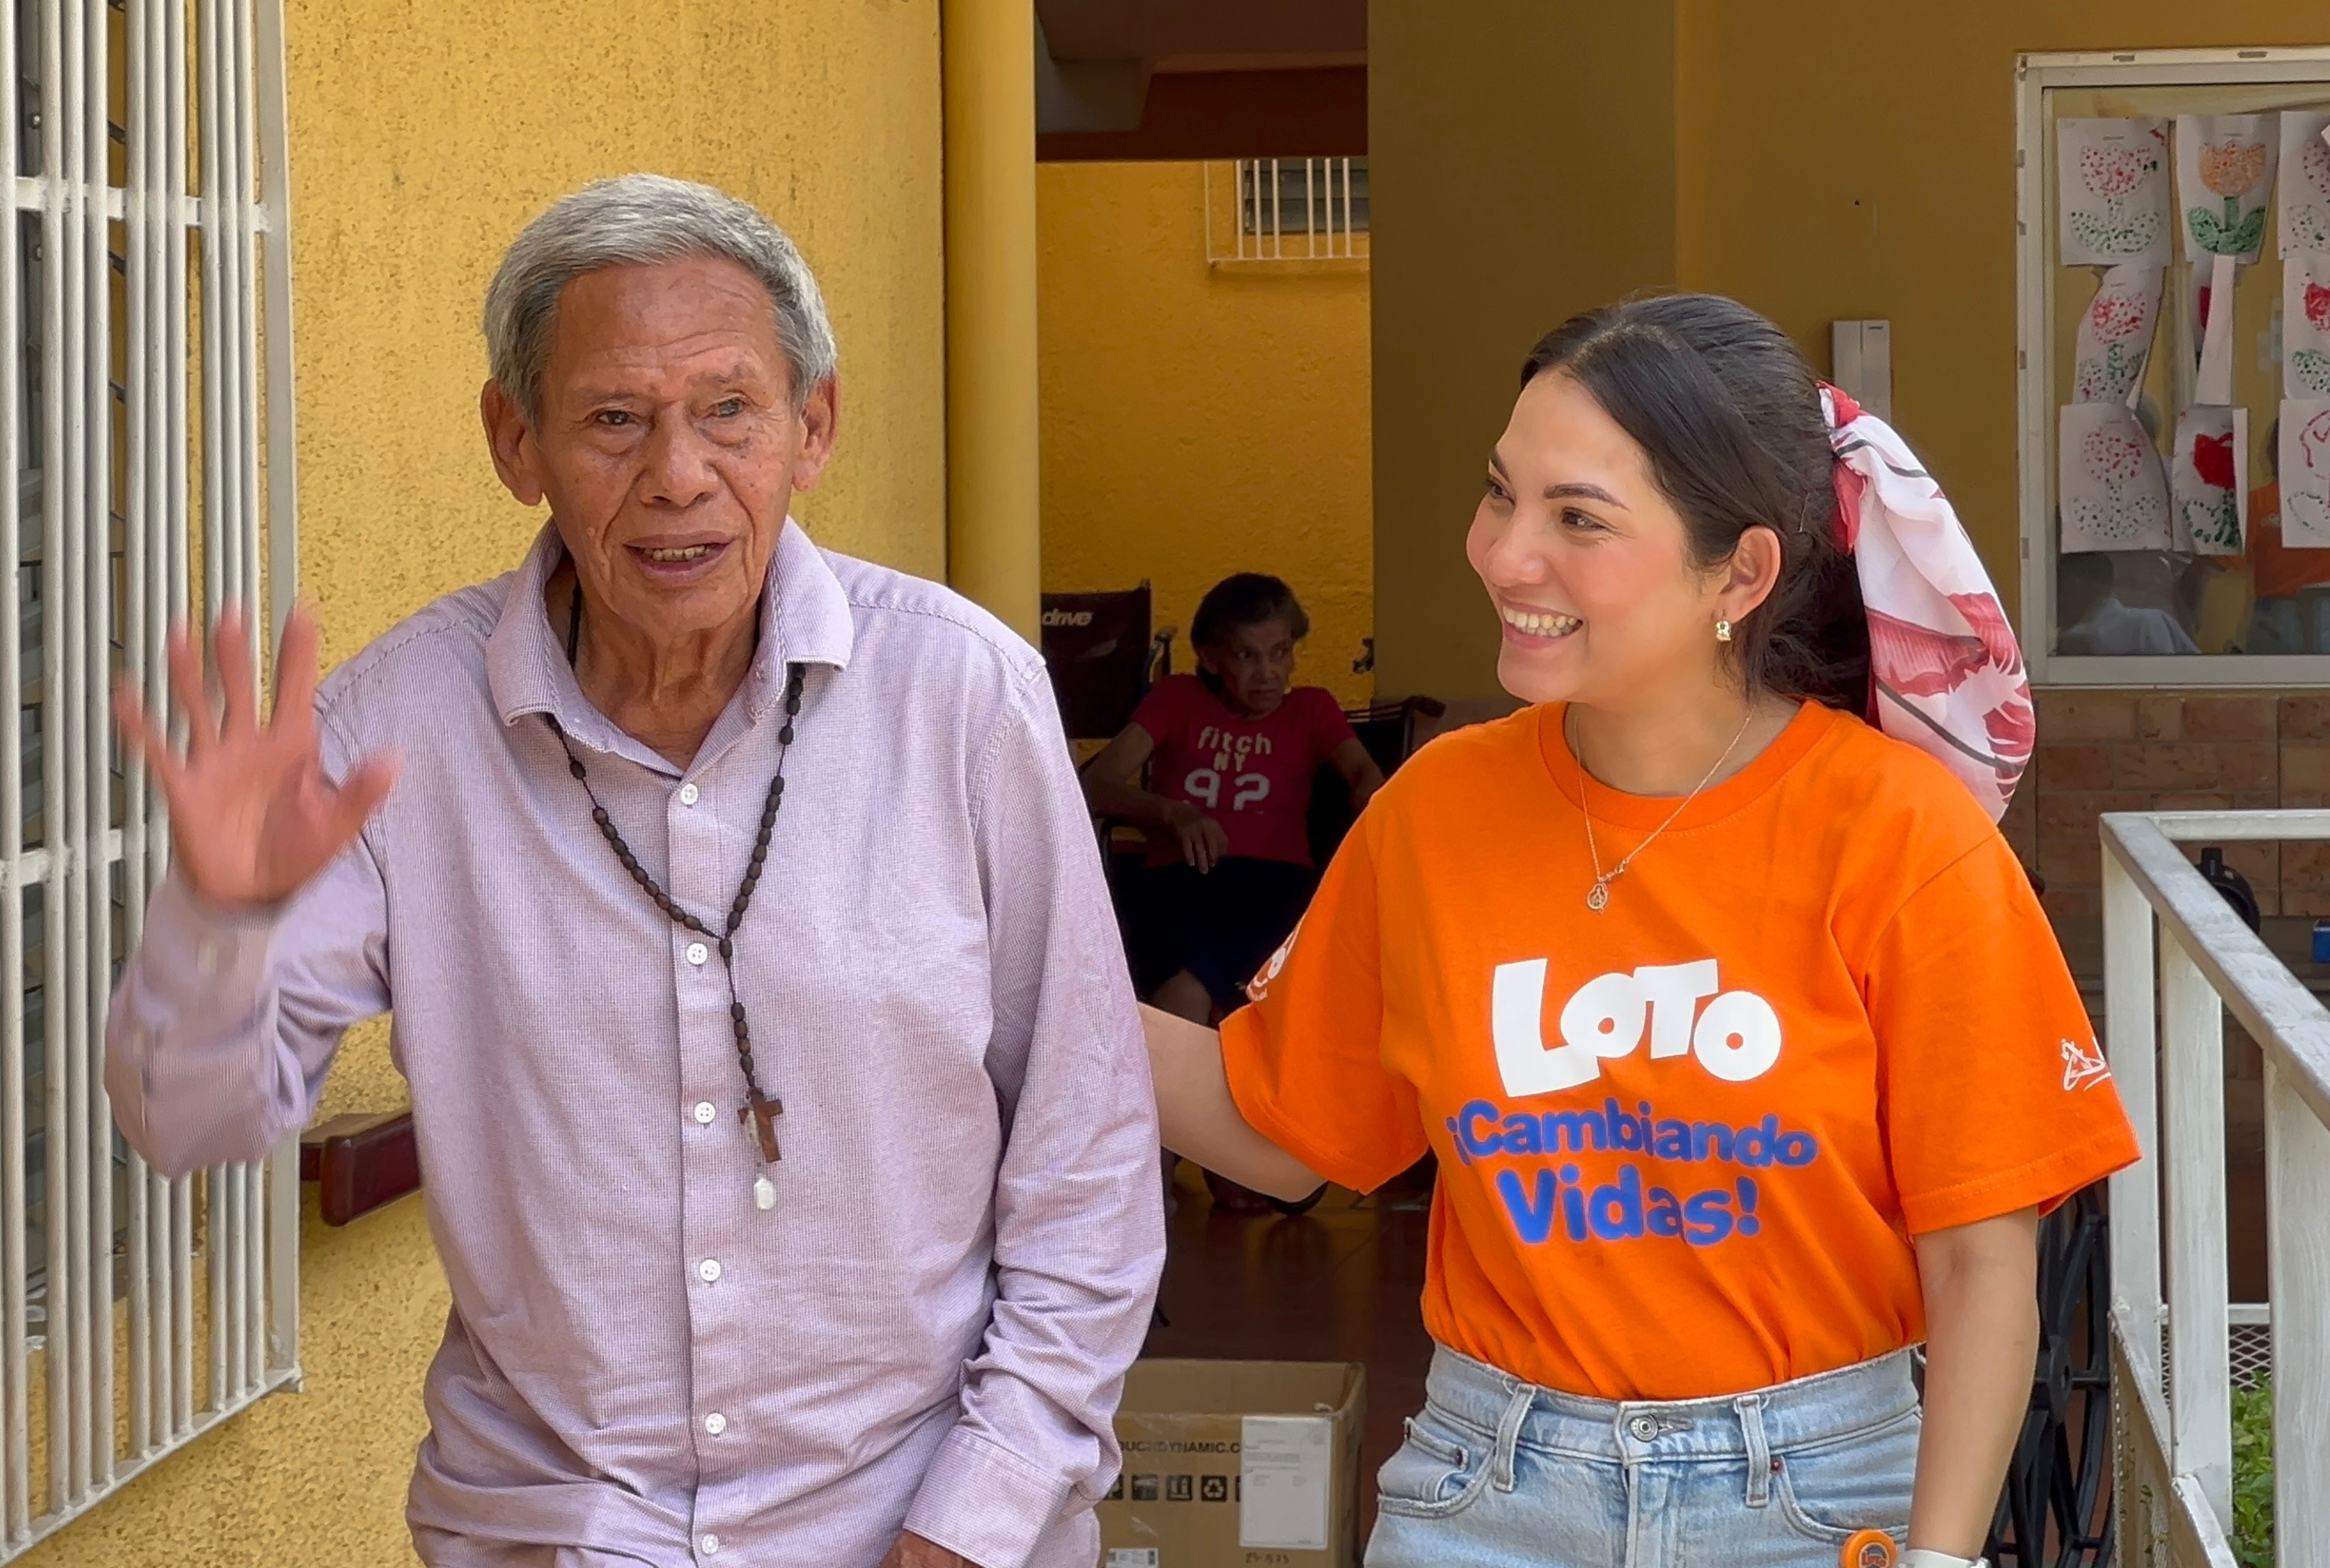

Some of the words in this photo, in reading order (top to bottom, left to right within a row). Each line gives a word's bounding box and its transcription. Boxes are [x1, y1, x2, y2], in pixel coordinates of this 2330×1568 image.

[1042, 608, 1093, 625] drive
[1197, 725, 1272, 755] fitch
[1213, 751, 1247, 772] NY
[1447, 1099, 1817, 1167] ¡Cambiando
[1497, 1165, 1760, 1246] Vidas!
